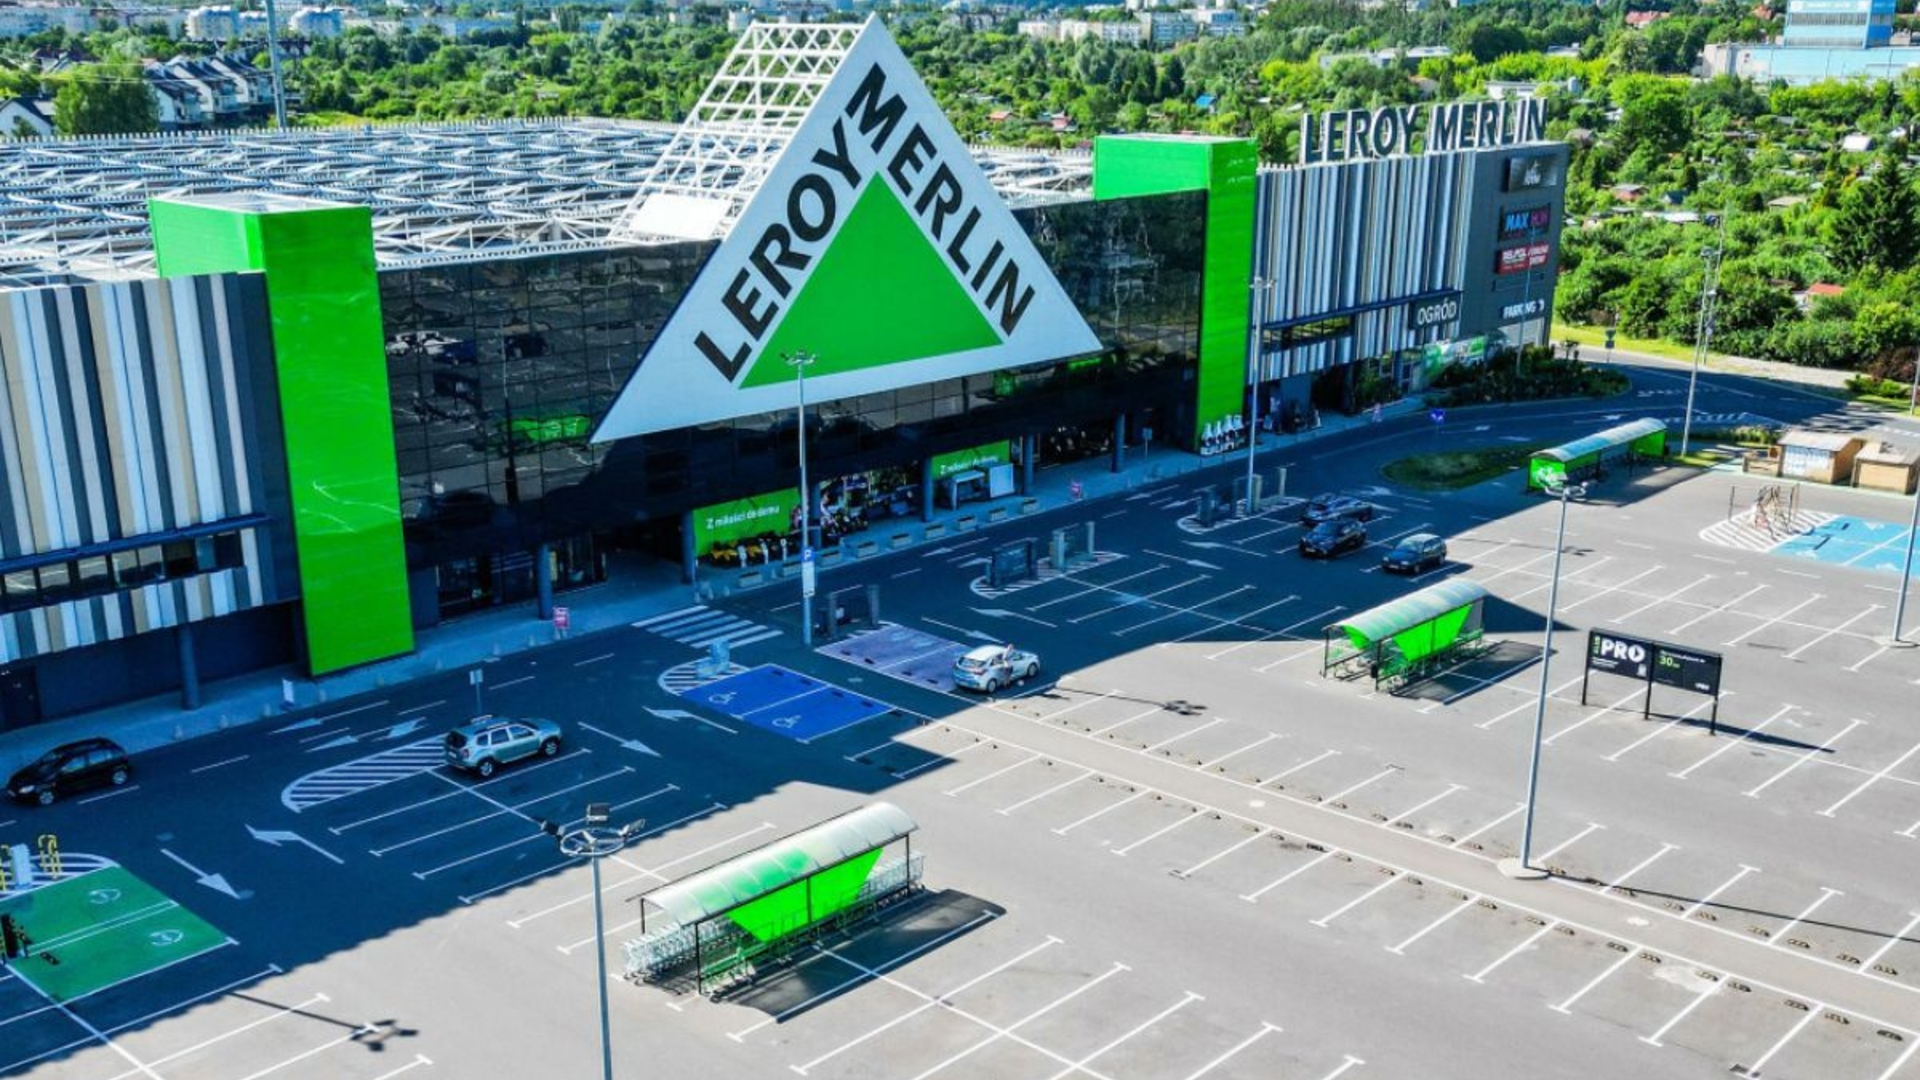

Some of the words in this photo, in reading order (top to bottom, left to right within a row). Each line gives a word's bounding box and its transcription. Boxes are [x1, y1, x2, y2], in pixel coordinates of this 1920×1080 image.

[1301, 104, 1418, 165] LEROY
[1430, 98, 1548, 151] MERLIN
[694, 117, 862, 383] LEROY
[845, 61, 1036, 336] MERLIN
[1505, 212, 1529, 232] MAX
[1417, 296, 1457, 325] OGRÓD
[706, 517, 714, 531] Z
[804, 549, 812, 561] P
[1601, 639, 1645, 662] PRO
